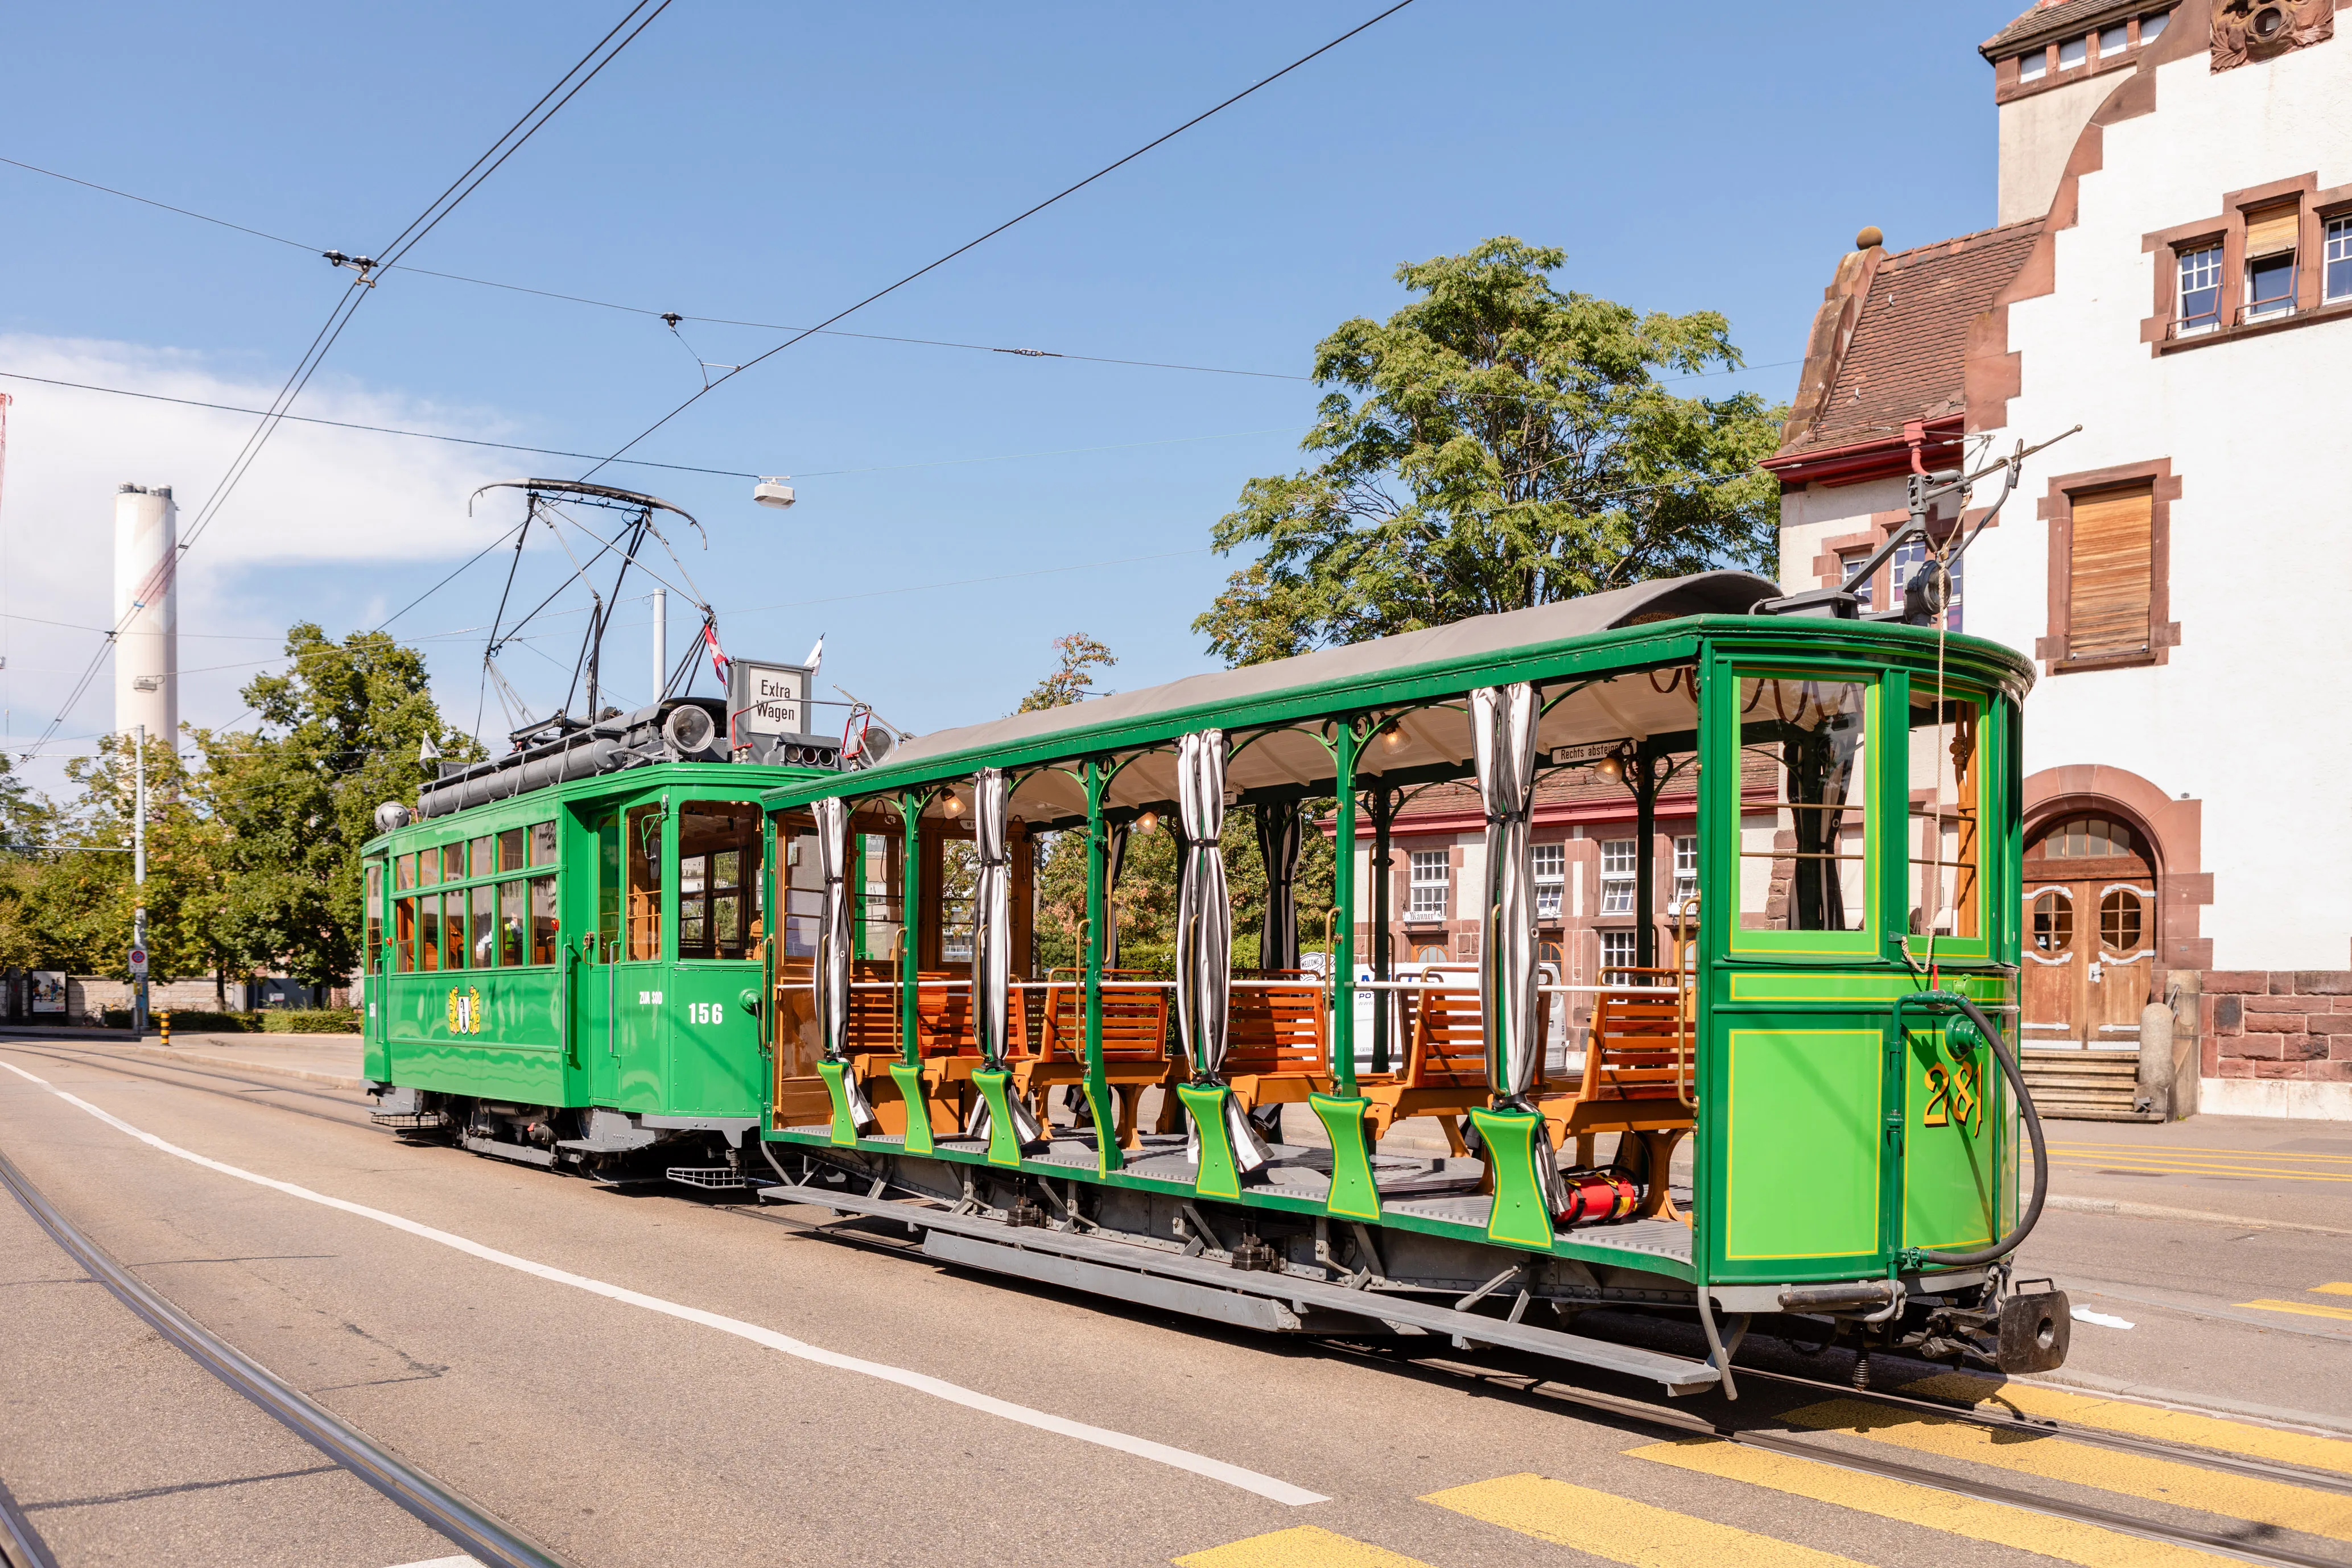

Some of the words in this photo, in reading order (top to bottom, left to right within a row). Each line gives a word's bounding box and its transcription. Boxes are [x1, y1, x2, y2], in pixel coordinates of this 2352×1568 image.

[761, 679, 790, 698] Extra
[756, 700, 794, 722] Wagen
[1561, 747, 1584, 760] Rechts
[1410, 911, 1434, 921] Männer
[1301, 958, 1320, 968] WELCOME
[639, 991, 650, 1005] ZUM
[651, 991, 663, 1005] SOD
[688, 1003, 723, 1025] 156
[1924, 1061, 1983, 1139] 281
